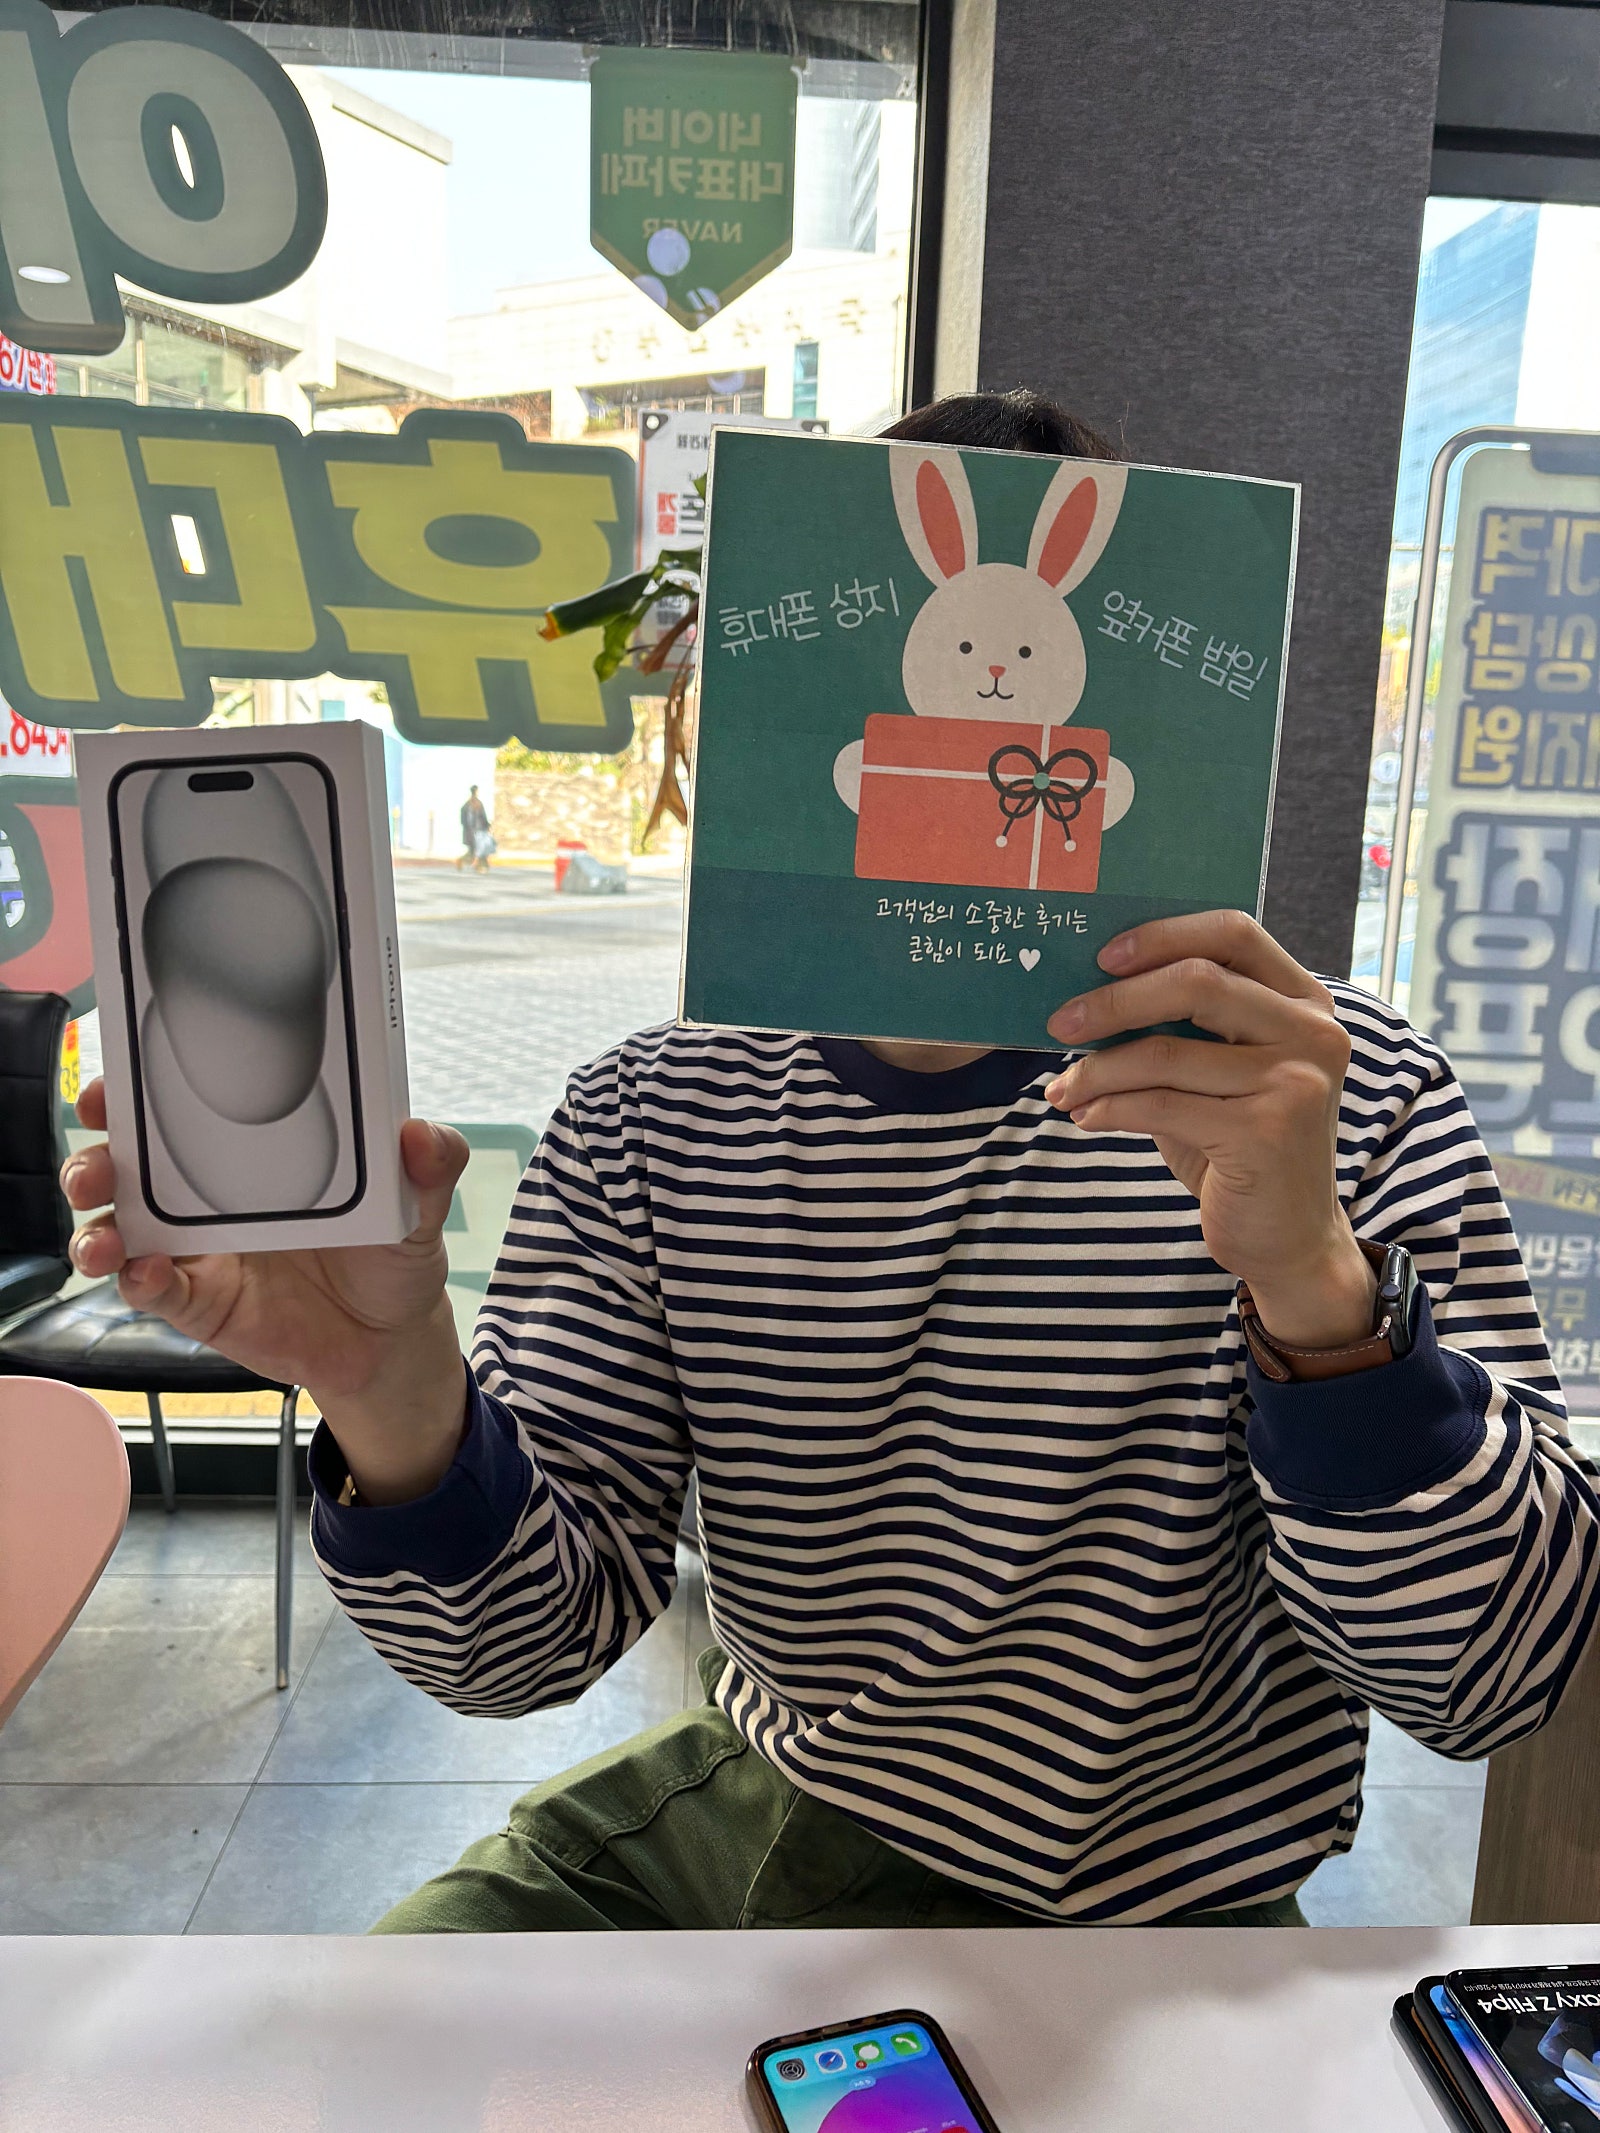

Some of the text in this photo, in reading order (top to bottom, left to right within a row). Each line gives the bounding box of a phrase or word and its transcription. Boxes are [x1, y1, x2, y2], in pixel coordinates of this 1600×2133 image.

[719, 590, 821, 656] 휴대폰
[829, 577, 900, 629] 성지
[1097, 590, 1269, 701] 옆카폰 범일
[876, 898, 1089, 936] 고객님의 소중한 후기는
[908, 935, 1012, 965] 큰힘이 되요
[1477, 1991, 1600, 2014] axy Z Flip4
